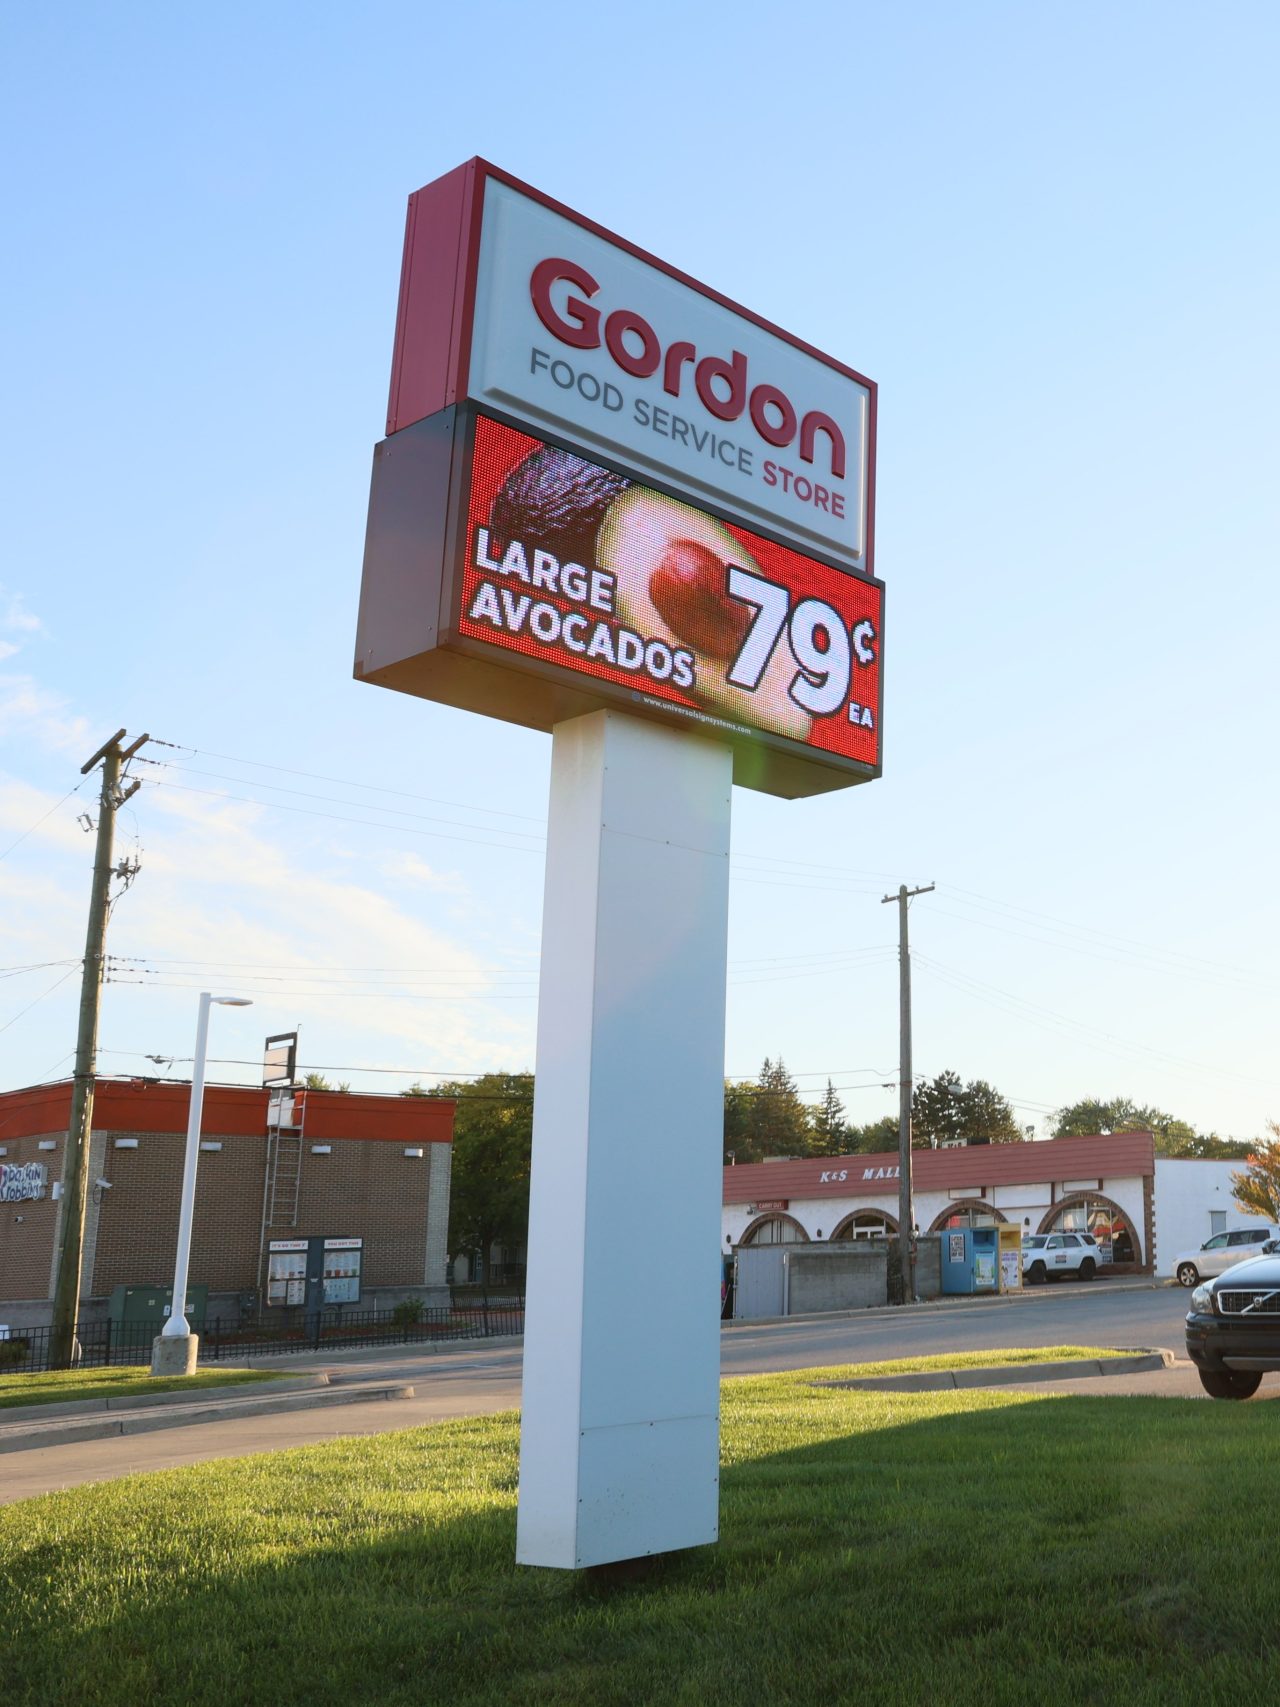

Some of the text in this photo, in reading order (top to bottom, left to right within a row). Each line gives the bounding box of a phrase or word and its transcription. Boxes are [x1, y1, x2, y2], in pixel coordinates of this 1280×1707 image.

[529, 257, 846, 480] Gordon
[530, 347, 846, 520] FOOD SERVICE STORE
[476, 528, 615, 612] LARGE
[469, 582, 693, 687] AVOCADOS
[643, 695, 752, 735] www.universalsignsystems.com
[848, 702, 874, 728] EA
[862, 1165, 900, 1181] MALL
